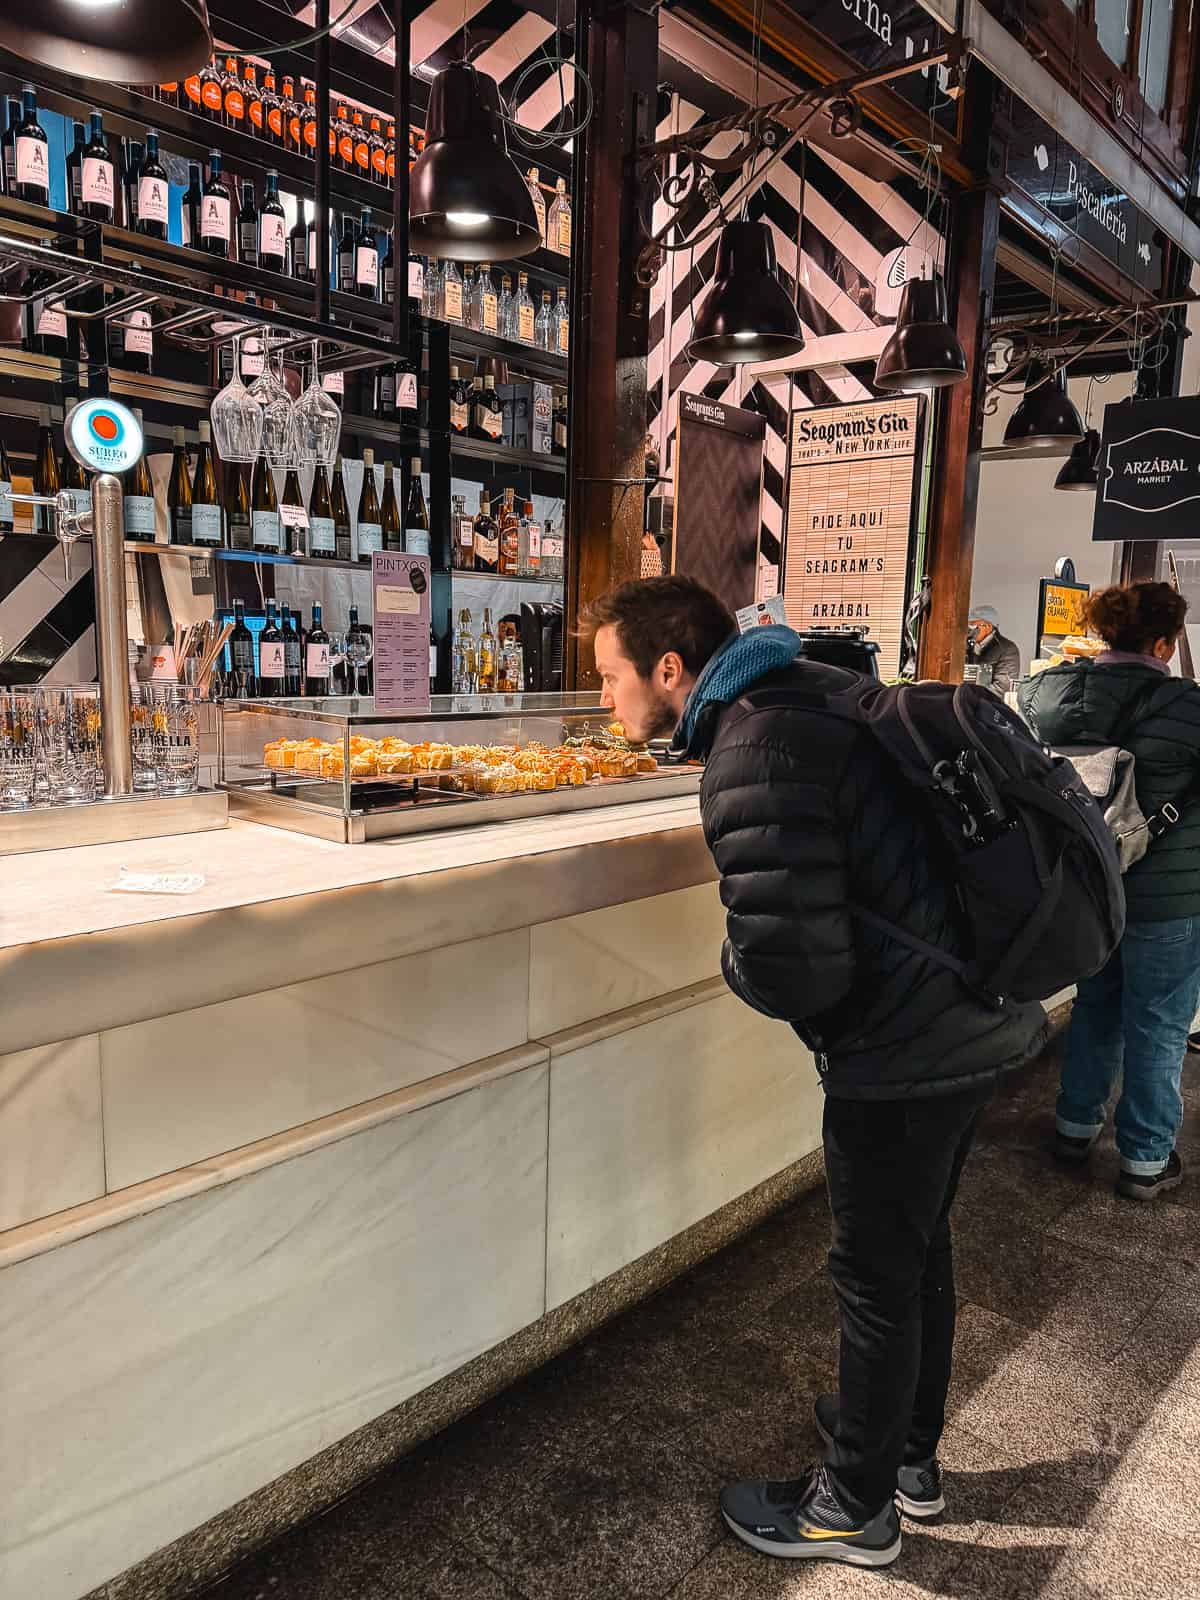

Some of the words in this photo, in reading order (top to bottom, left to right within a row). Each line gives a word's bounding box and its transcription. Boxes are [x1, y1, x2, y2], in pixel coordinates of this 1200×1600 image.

[1068, 160, 1127, 245] Pescadería
[798, 416, 876, 445] Seagram's
[878, 412, 910, 434] Gin
[835, 440, 859, 455] NEW
[862, 437, 891, 452] YORK
[1123, 457, 1188, 475] ARZÁBAL
[1137, 475, 1172, 485] MARKET
[812, 514, 843, 529] PIDE
[849, 508, 883, 529] AQUÍ
[838, 536, 853, 551] TU
[806, 557, 884, 574] SEAGRAM'S
